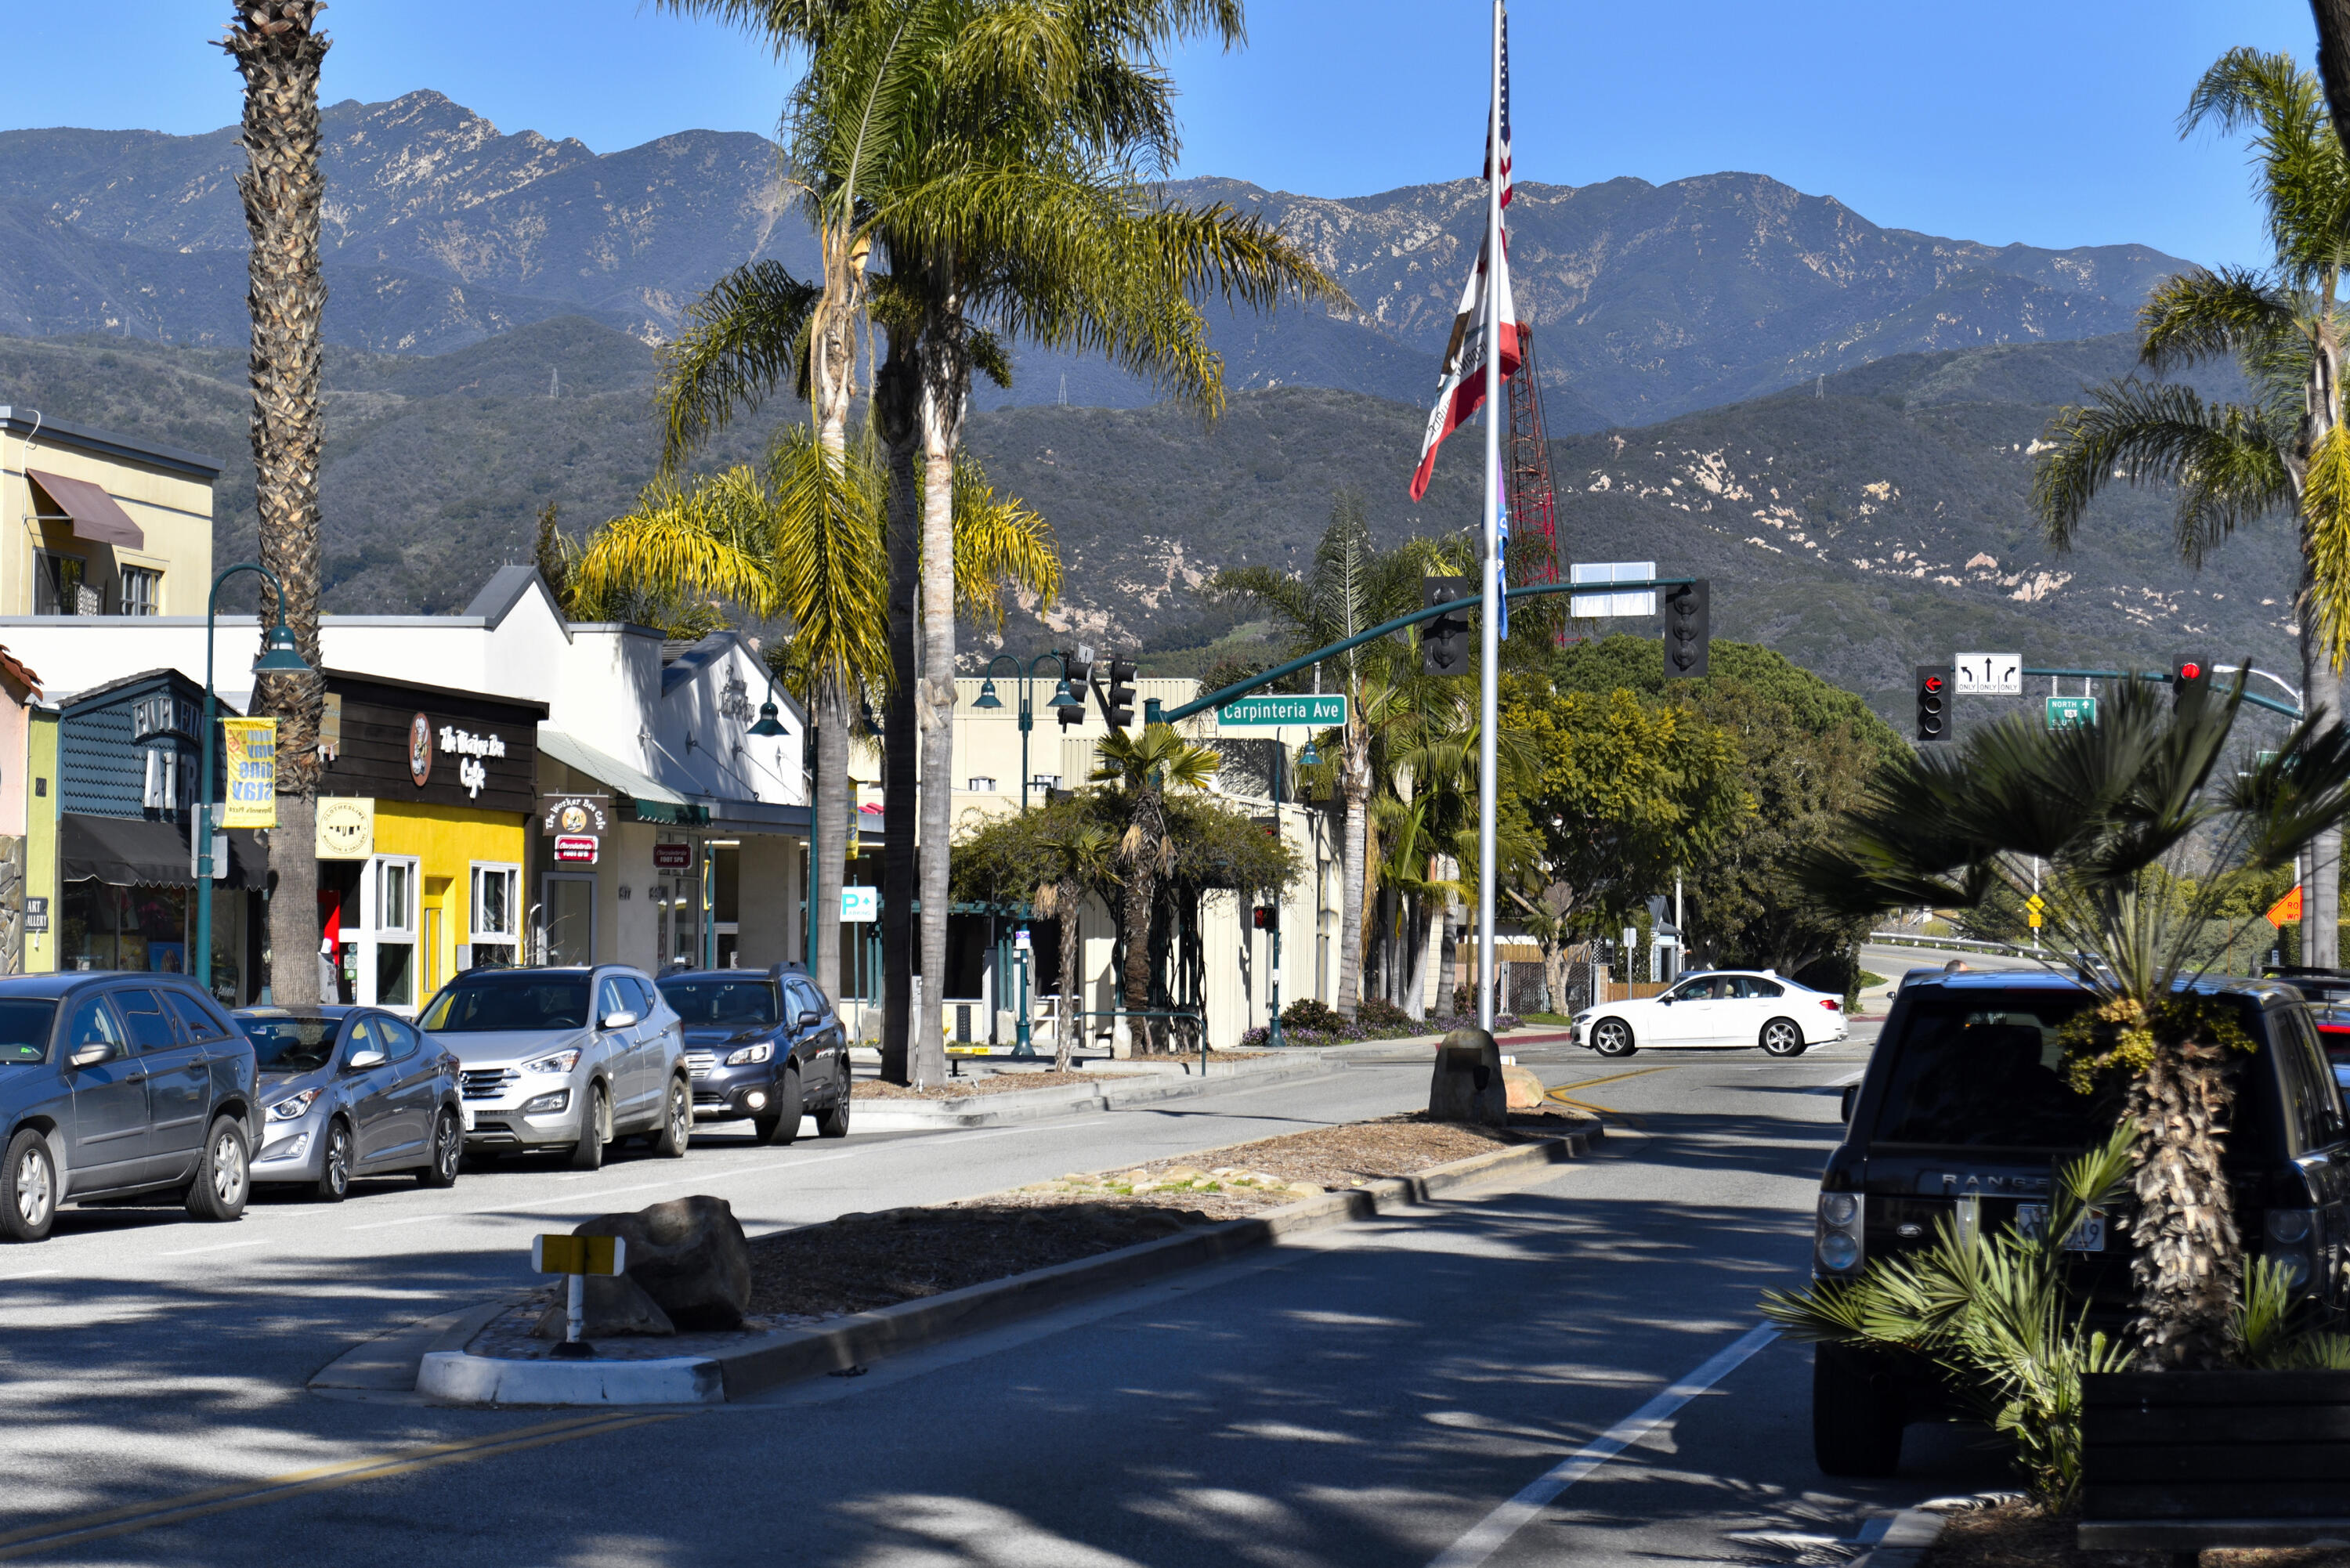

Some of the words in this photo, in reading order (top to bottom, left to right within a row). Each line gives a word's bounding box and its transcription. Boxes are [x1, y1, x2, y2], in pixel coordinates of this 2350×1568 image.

[1224, 703, 1307, 722] Carpinteria
[1313, 702, 1339, 718] Ave
[439, 726, 457, 753] The
[456, 729, 489, 759] Worker
[489, 734, 505, 758] Bee
[144, 750, 197, 810] AIR
[460, 757, 486, 798] Cafe
[324, 805, 365, 821] CLOTHESLINE
[550, 797, 581, 814] Worker
[583, 799, 597, 812] Bee
[545, 814, 556, 829] The
[595, 811, 606, 830] Cafe
[27, 901, 41, 912] ART
[2287, 901, 2299, 910] RO
[1942, 1174, 2049, 1187] RANGE
